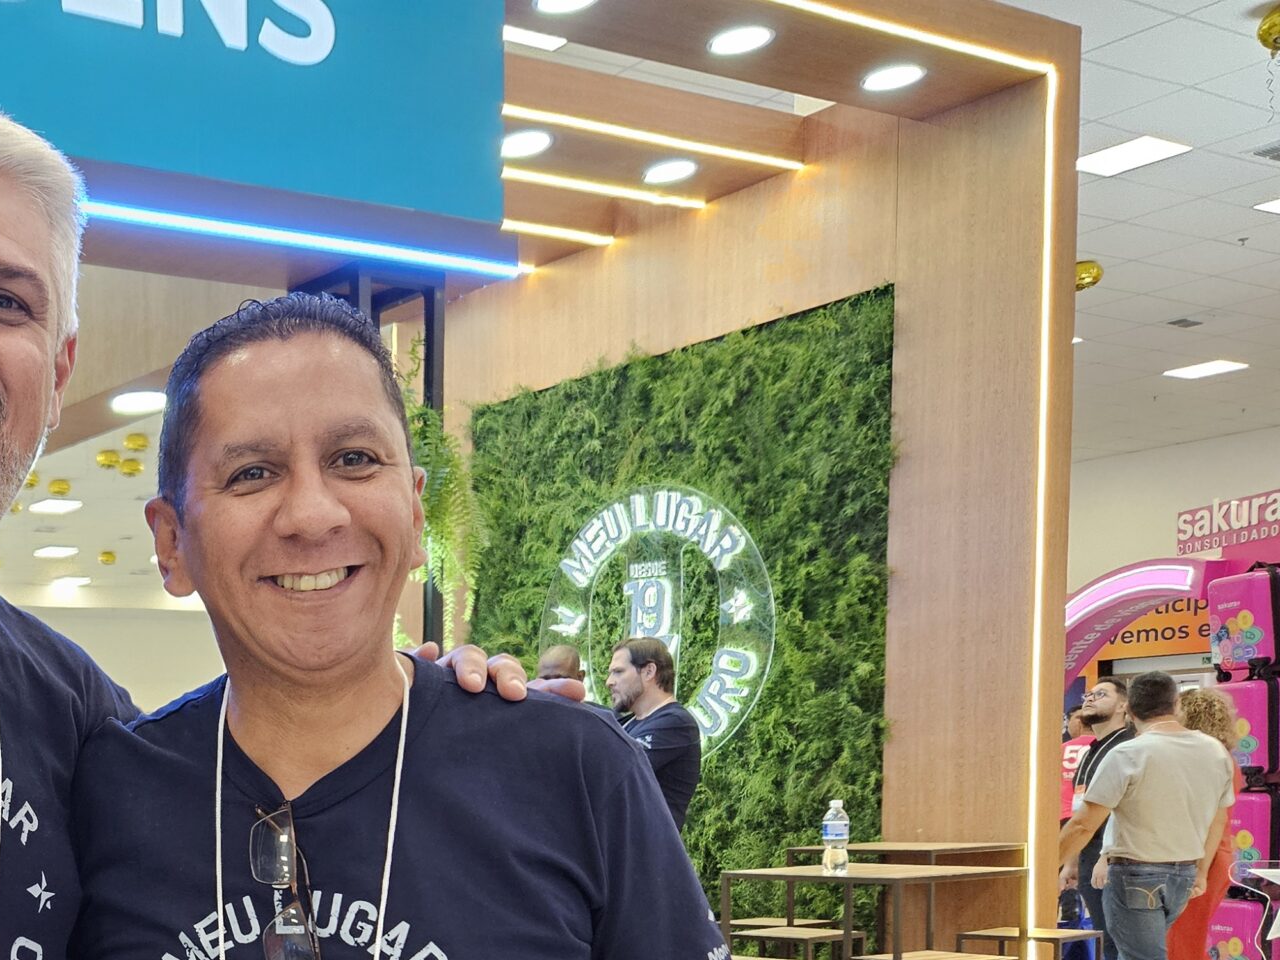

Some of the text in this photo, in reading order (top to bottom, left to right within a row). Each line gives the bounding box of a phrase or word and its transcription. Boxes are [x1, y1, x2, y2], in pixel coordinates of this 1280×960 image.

[559, 491, 746, 588] MEU LUGAR
[1177, 492, 1280, 541] sakura
